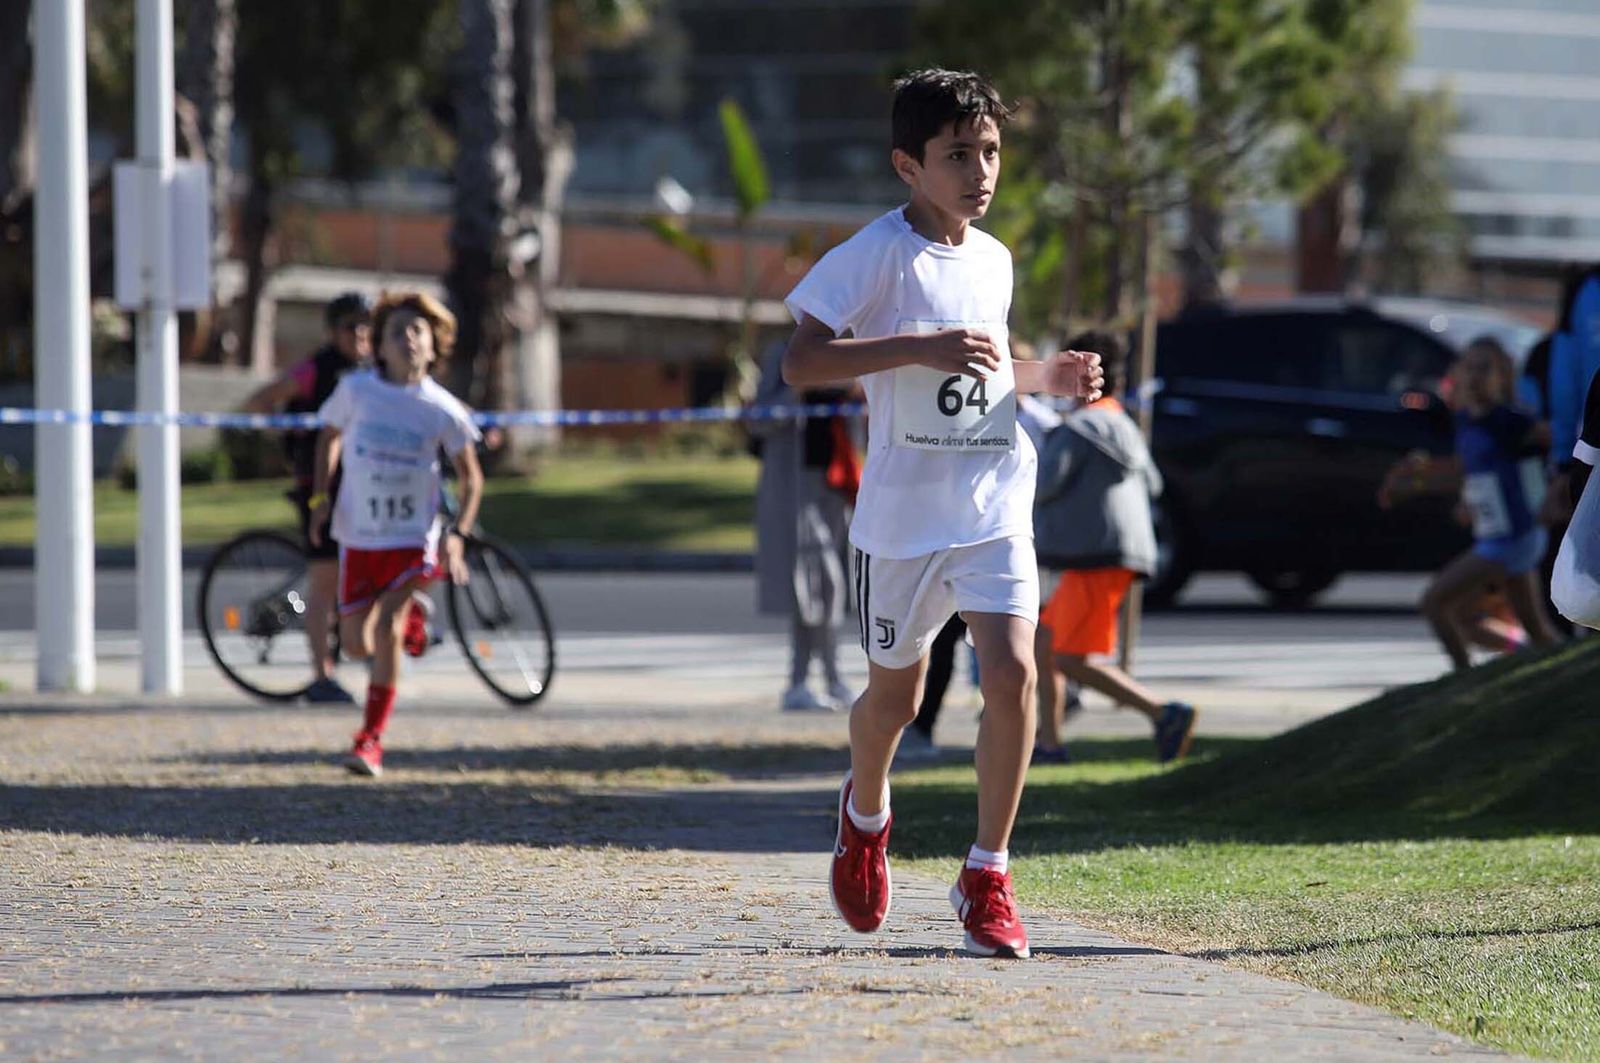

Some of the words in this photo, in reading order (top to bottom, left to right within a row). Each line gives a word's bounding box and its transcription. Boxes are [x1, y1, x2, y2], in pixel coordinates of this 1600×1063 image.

[937, 374, 988, 417] 64
[905, 433, 939, 446] Huelva
[368, 495, 415, 520] 115
